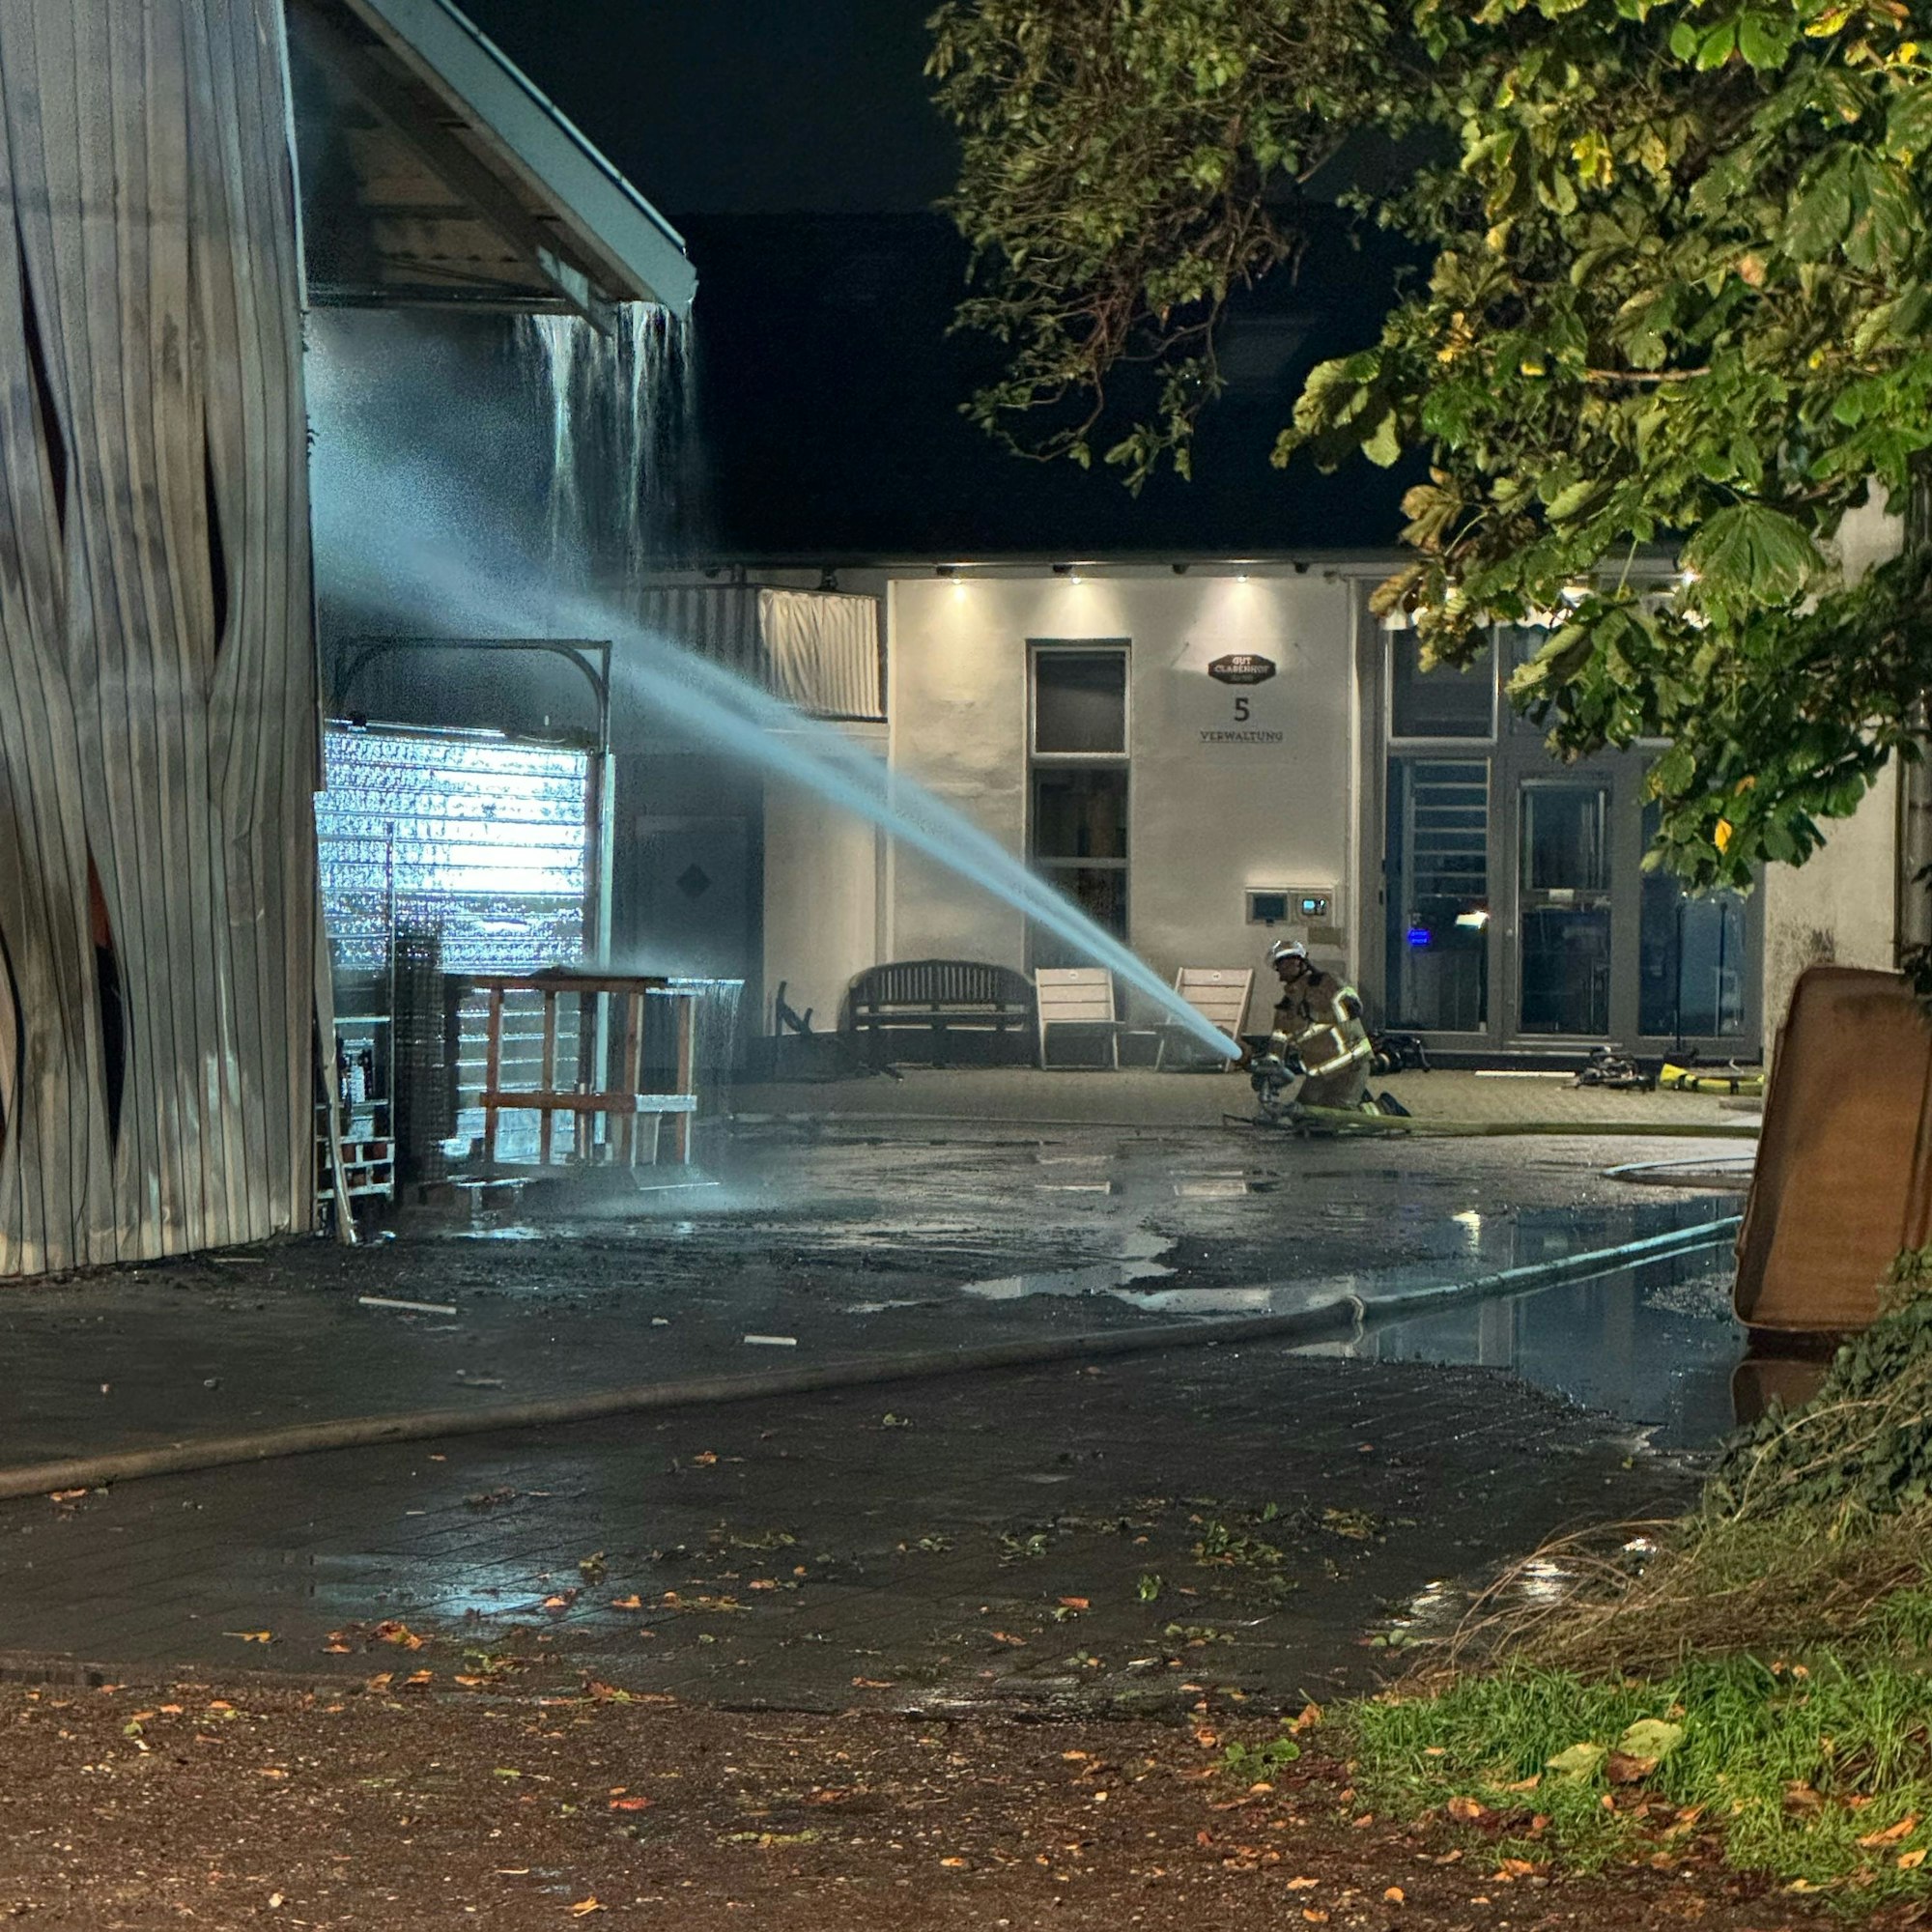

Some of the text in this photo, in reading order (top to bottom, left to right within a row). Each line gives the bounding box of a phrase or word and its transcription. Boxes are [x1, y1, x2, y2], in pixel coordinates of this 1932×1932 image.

[1232, 656, 1253, 666] GUT
[1234, 696, 1250, 723] 5
[1200, 730, 1283, 742] VERWALTUNG
